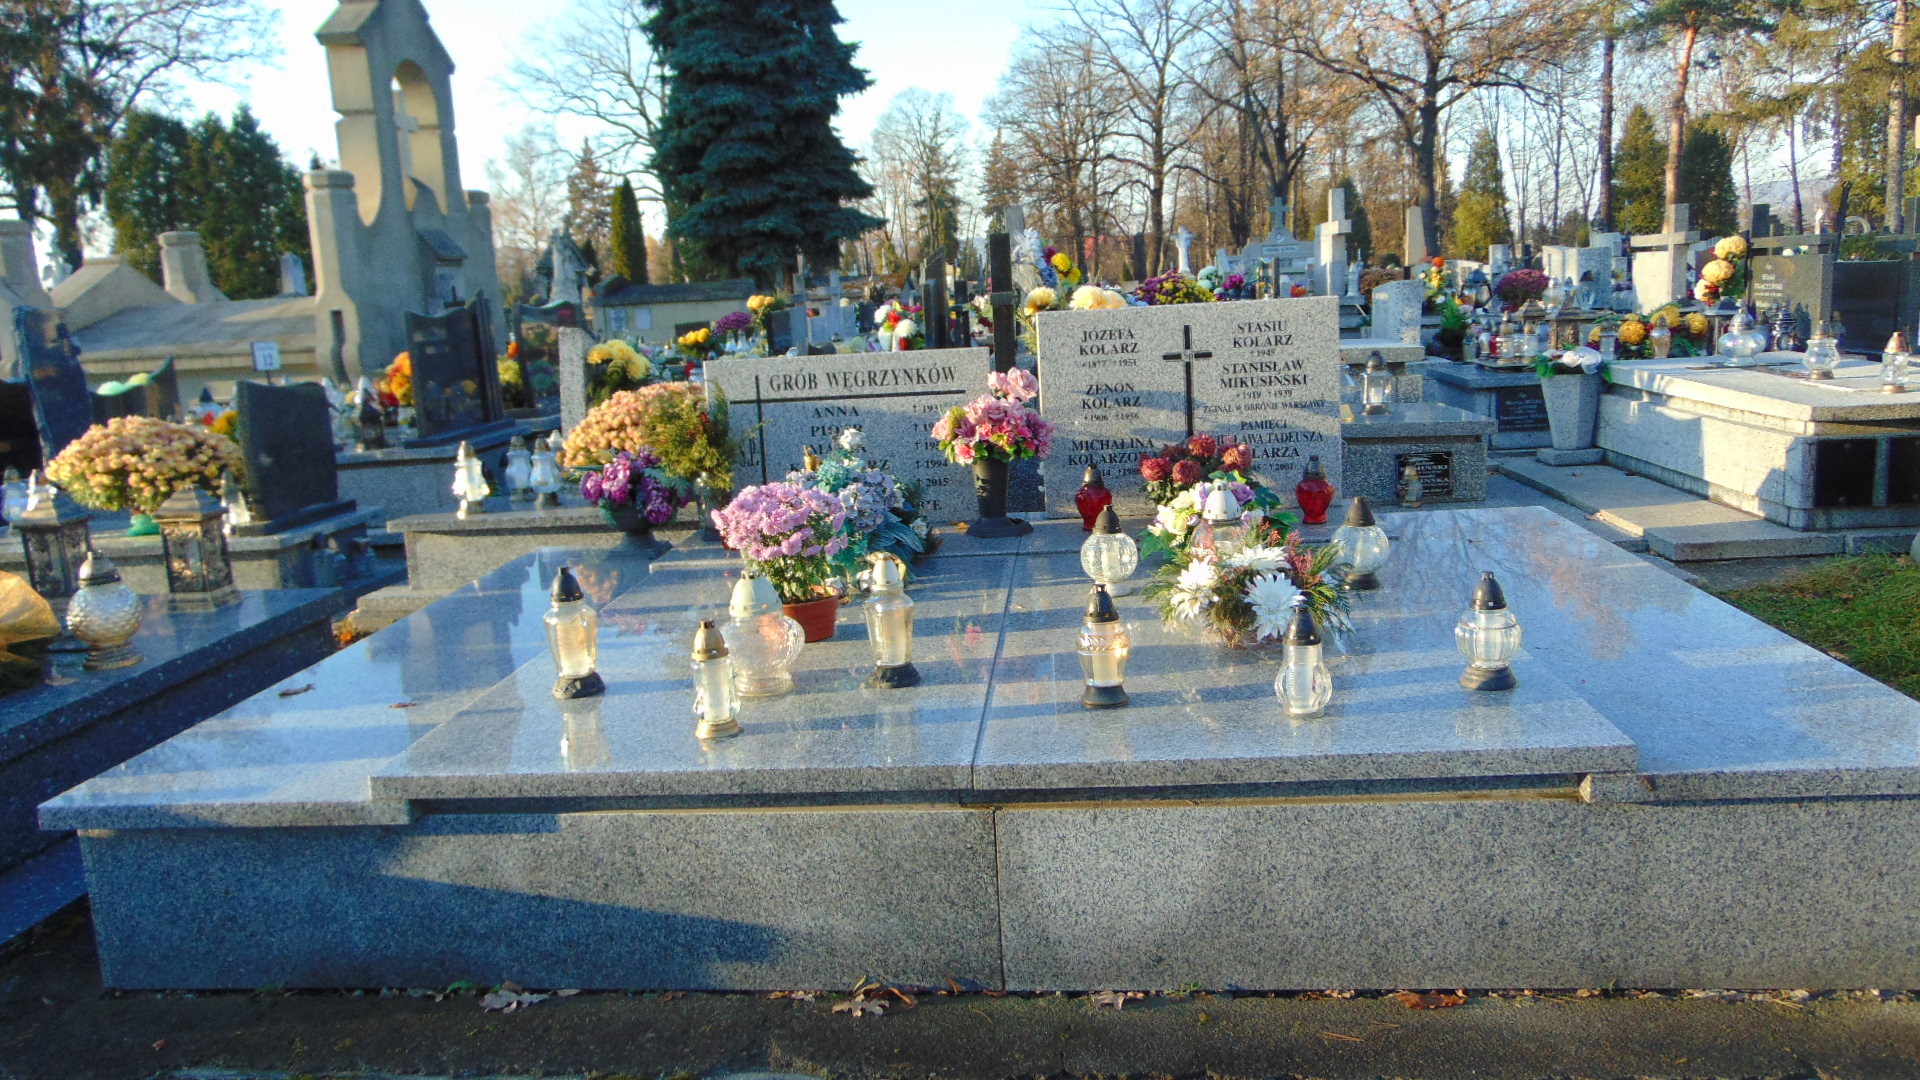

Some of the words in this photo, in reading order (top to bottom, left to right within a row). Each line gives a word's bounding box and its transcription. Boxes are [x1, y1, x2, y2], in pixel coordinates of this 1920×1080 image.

[1236, 320, 1287, 334] STASIU
[1081, 327, 1135, 343] JÓZEFA
[1233, 334, 1294, 349] KOLARZ
[1079, 342, 1140, 356] KOLARZ
[769, 368, 818, 392] GRÓB
[825, 361, 957, 392] WĘGRZYNKÓW
[1086, 382, 1135, 395] ZENON
[1081, 396, 1143, 410] KOLARZ
[812, 406, 859, 418] ANNA
[810, 424, 863, 437] PIOR
[1268, 431, 1324, 444] TADEUSZA
[1071, 438, 1154, 452] MICHALINA
[1251, 447, 1300, 459] LARZA
[925, 459, 949, 470] 1994
[926, 477, 949, 487] 2015
